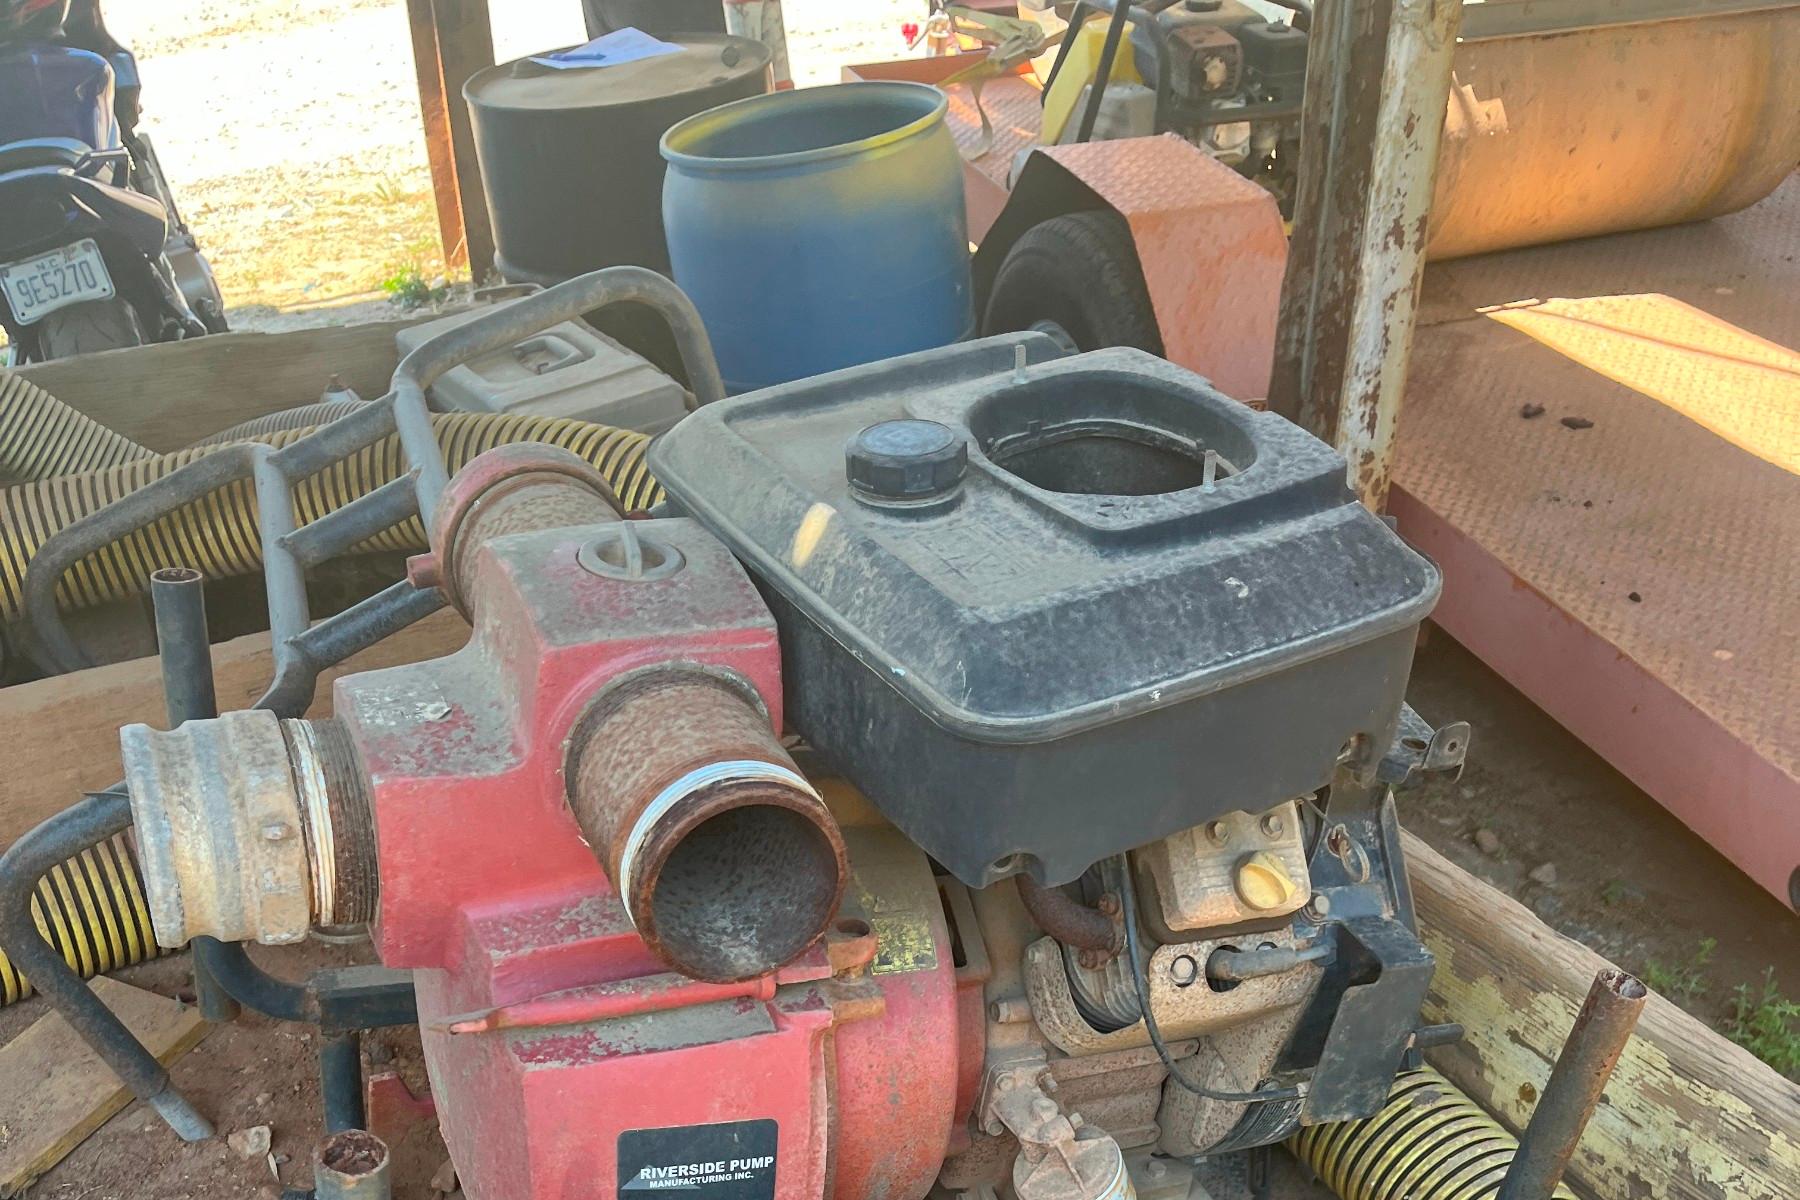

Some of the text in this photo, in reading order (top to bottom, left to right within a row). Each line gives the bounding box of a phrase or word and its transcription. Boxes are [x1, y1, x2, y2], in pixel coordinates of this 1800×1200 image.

[16, 260, 97, 308] 9E5270
[640, 1156, 774, 1179] RIVERSIDE PUMP
[649, 1174, 732, 1189] MANUFACTURING
